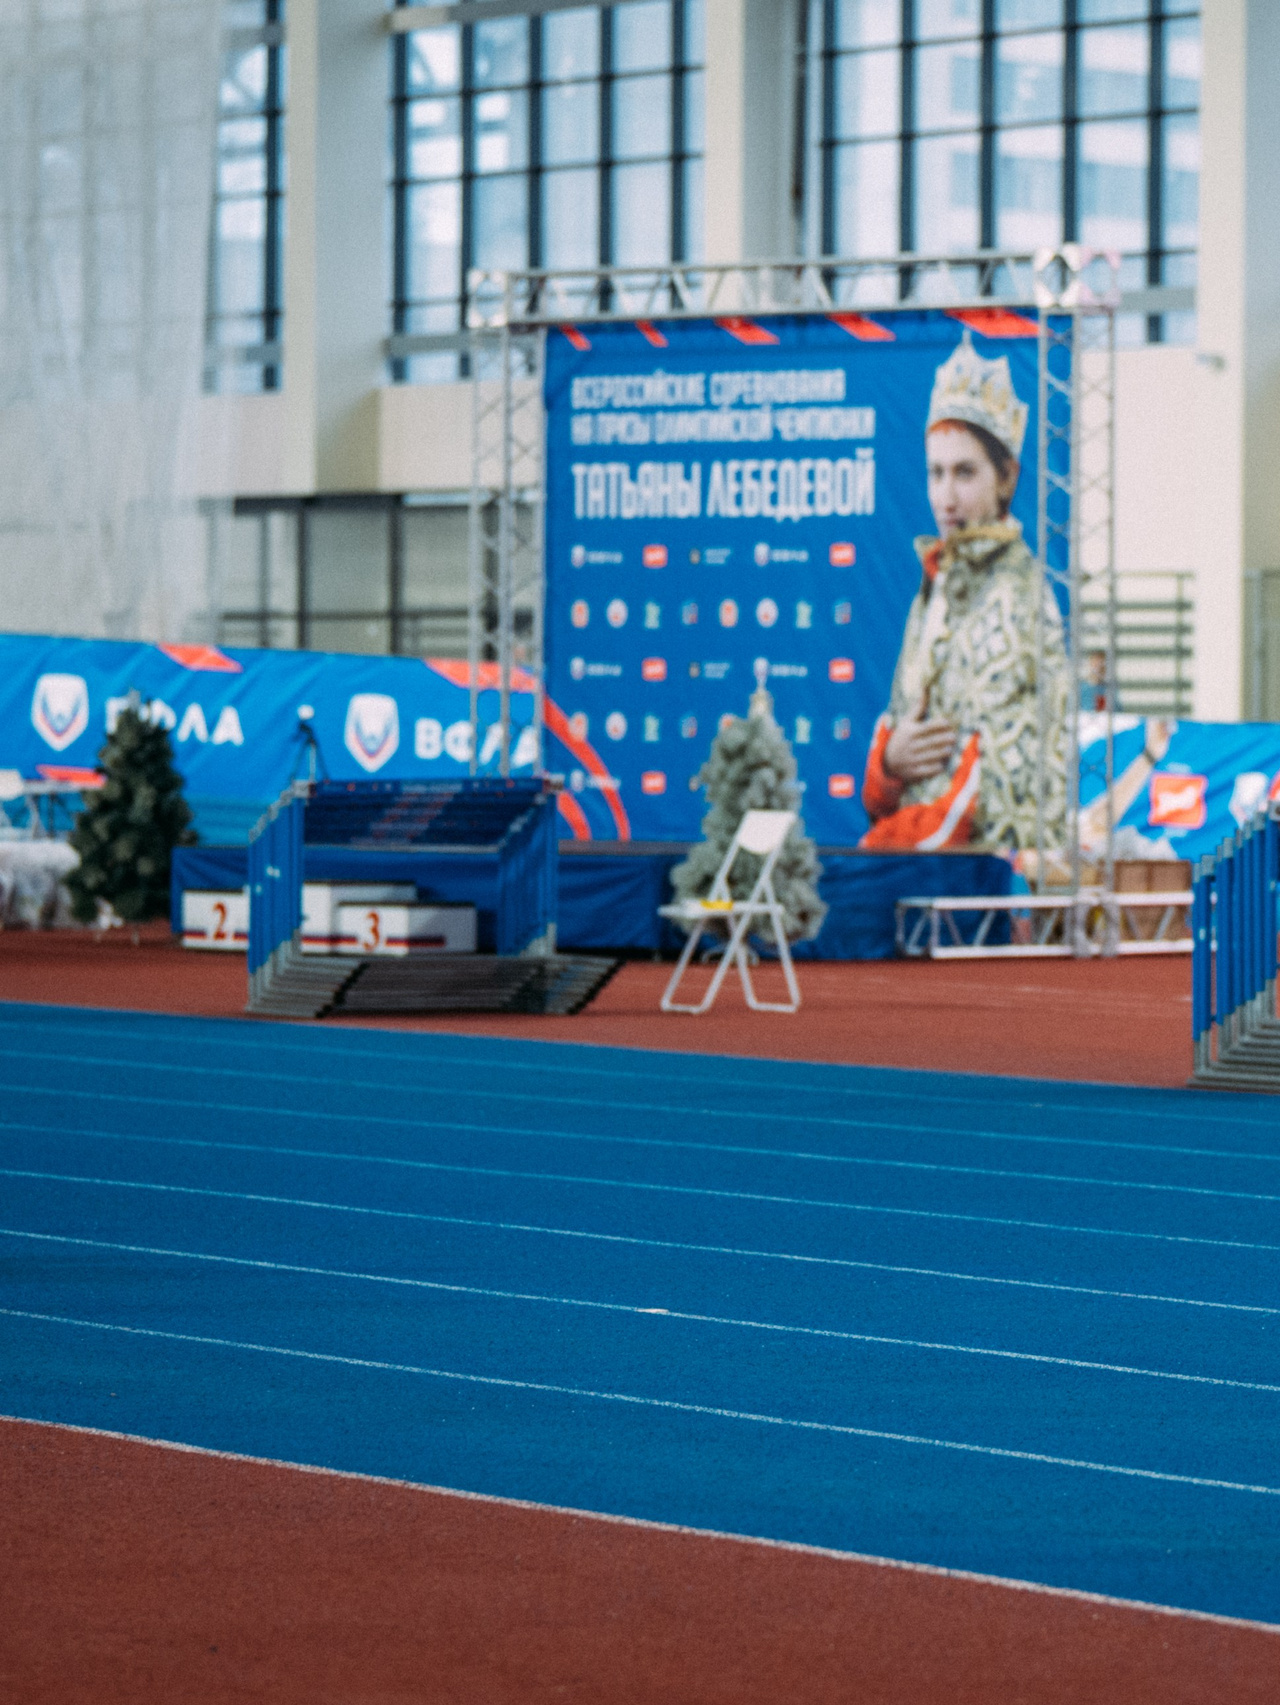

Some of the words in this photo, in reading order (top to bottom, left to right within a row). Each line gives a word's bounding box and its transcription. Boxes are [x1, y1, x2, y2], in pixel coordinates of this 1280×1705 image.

[571, 461, 702, 520] ТАТЬЯНЫ
[706, 447, 876, 523] ЛЕБЕДЕВОЙ
[212, 901, 228, 941] 2
[362, 910, 380, 951] 3
